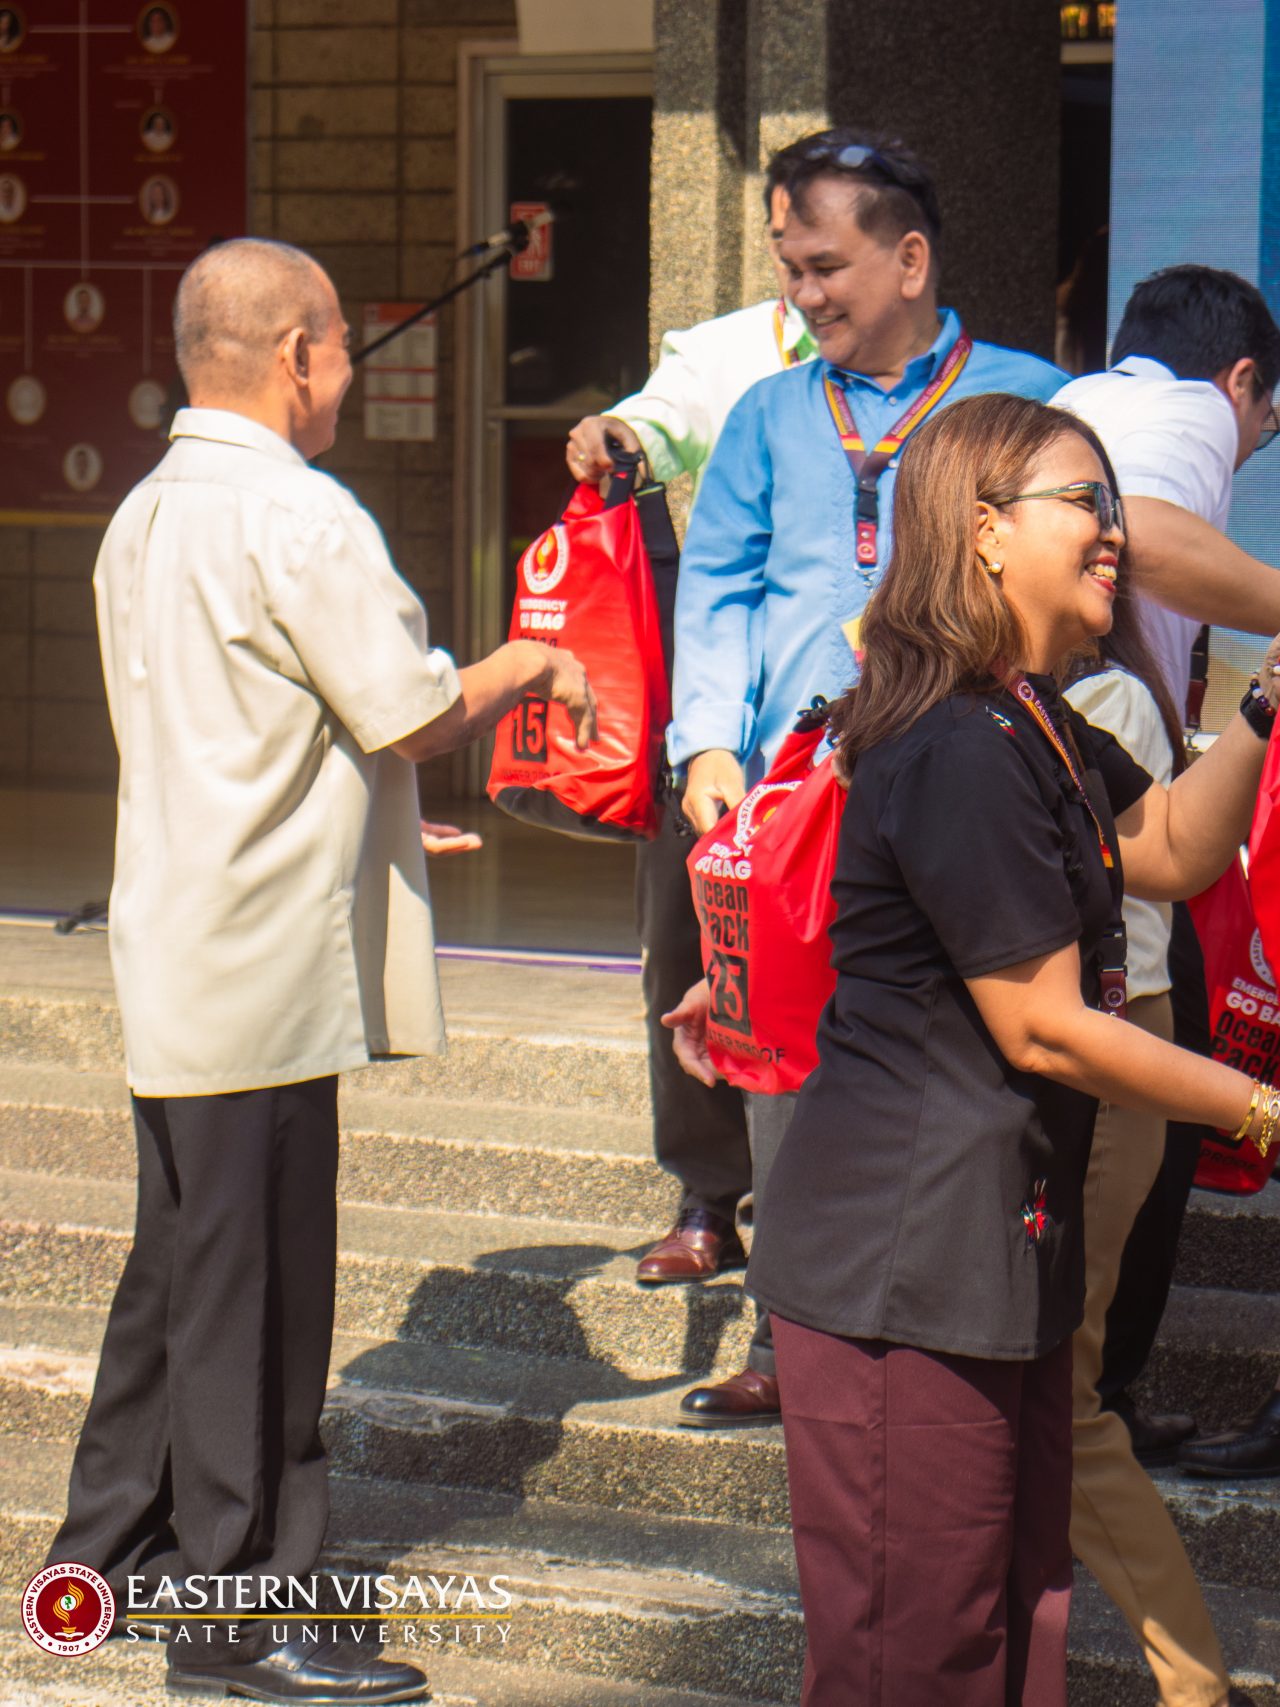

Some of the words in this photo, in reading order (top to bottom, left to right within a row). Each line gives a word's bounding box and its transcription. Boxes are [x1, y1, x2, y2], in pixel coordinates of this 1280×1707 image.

[512, 702, 545, 755] 15
[712, 858, 752, 880] BAG
[1225, 991, 1258, 1016] GO
